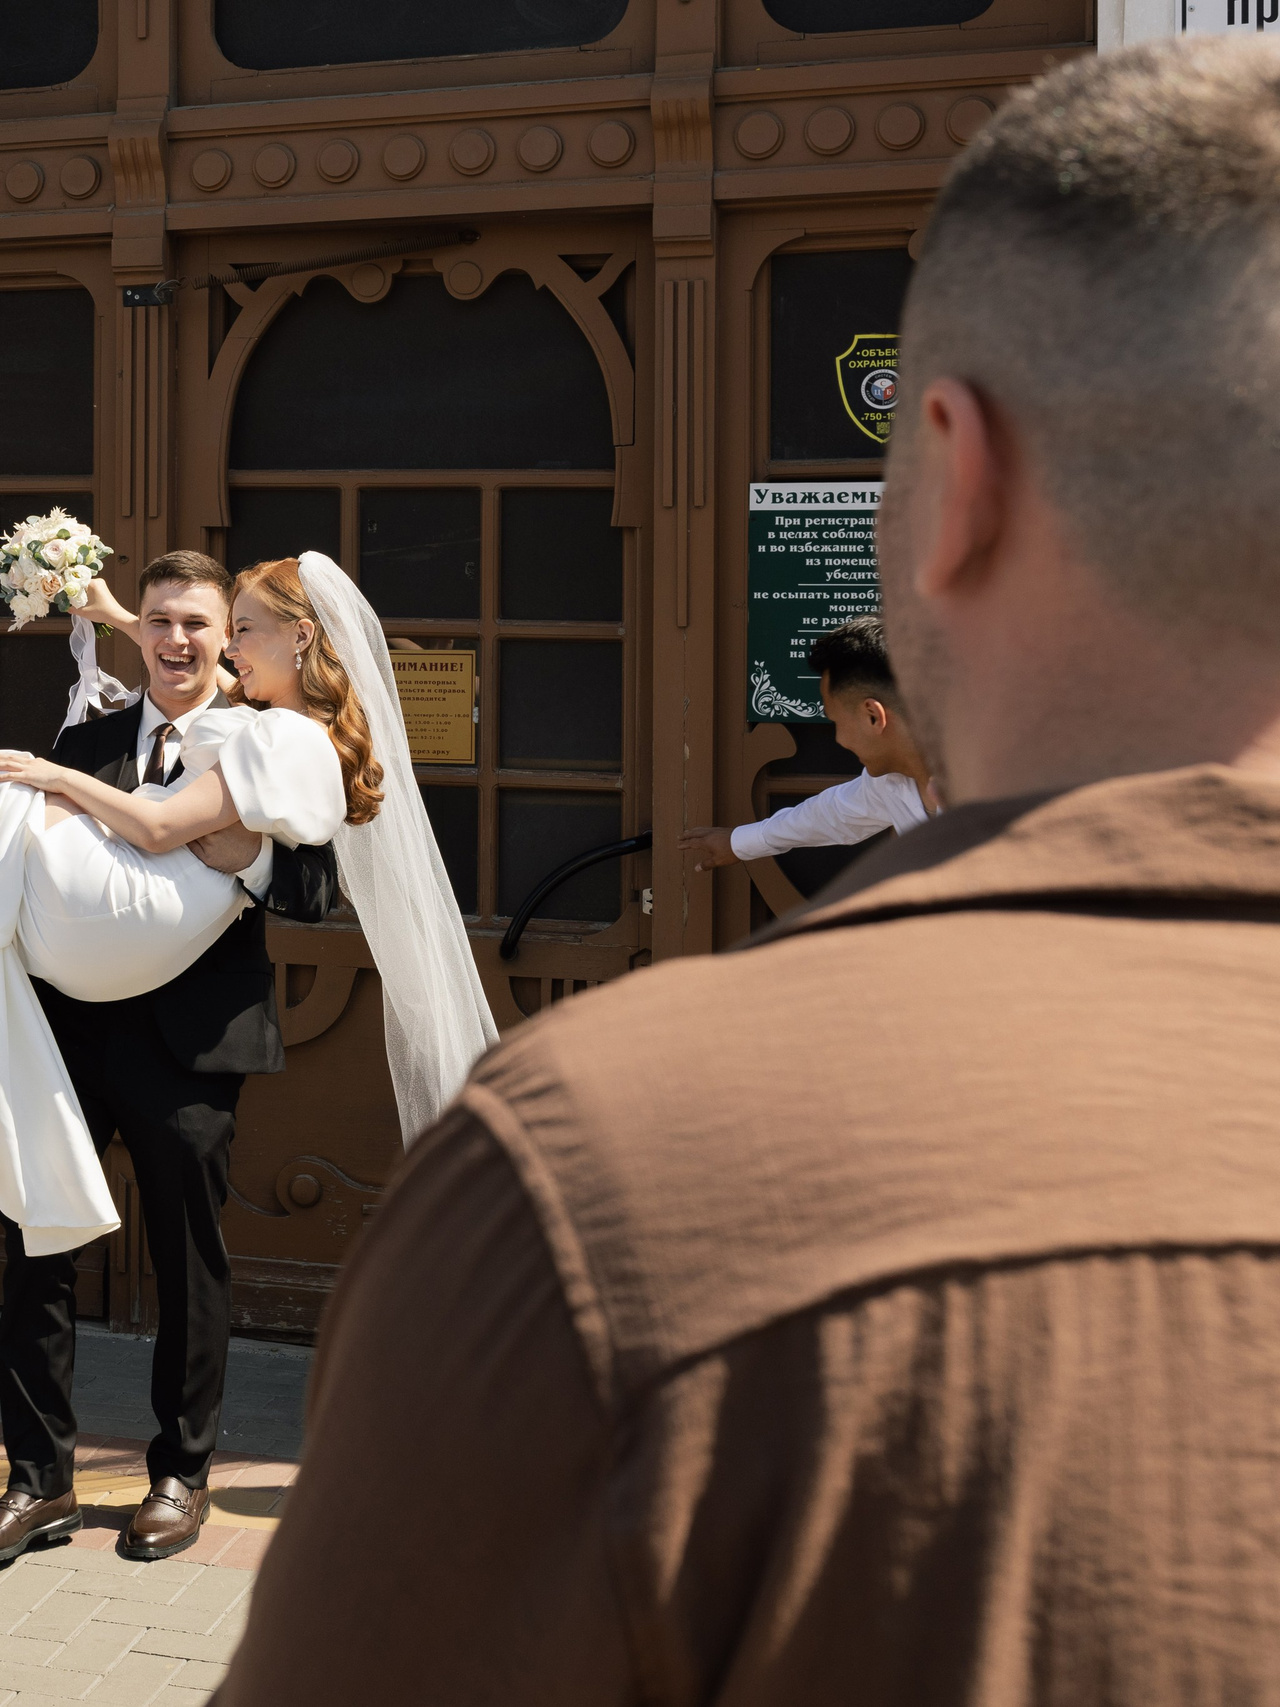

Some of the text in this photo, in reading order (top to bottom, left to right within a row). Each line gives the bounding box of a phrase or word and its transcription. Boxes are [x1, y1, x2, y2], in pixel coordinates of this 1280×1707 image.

[861, 348, 899, 357] ОБЪЕК
[848, 359, 898, 369] ОХРАНЯЕ
[754, 488, 885, 504] Уважаемы
[775, 516, 800, 528] При
[780, 531, 818, 540] целях
[822, 528, 878, 540] соблюде
[789, 542, 864, 552] избежание
[805, 558, 879, 567] из помеще
[826, 568, 880, 581] убедите
[833, 589, 883, 601] новобр
[802, 615, 853, 627] не разб
[790, 638, 806, 646] не
[392, 662, 463, 672] ИМАНИЕ!
